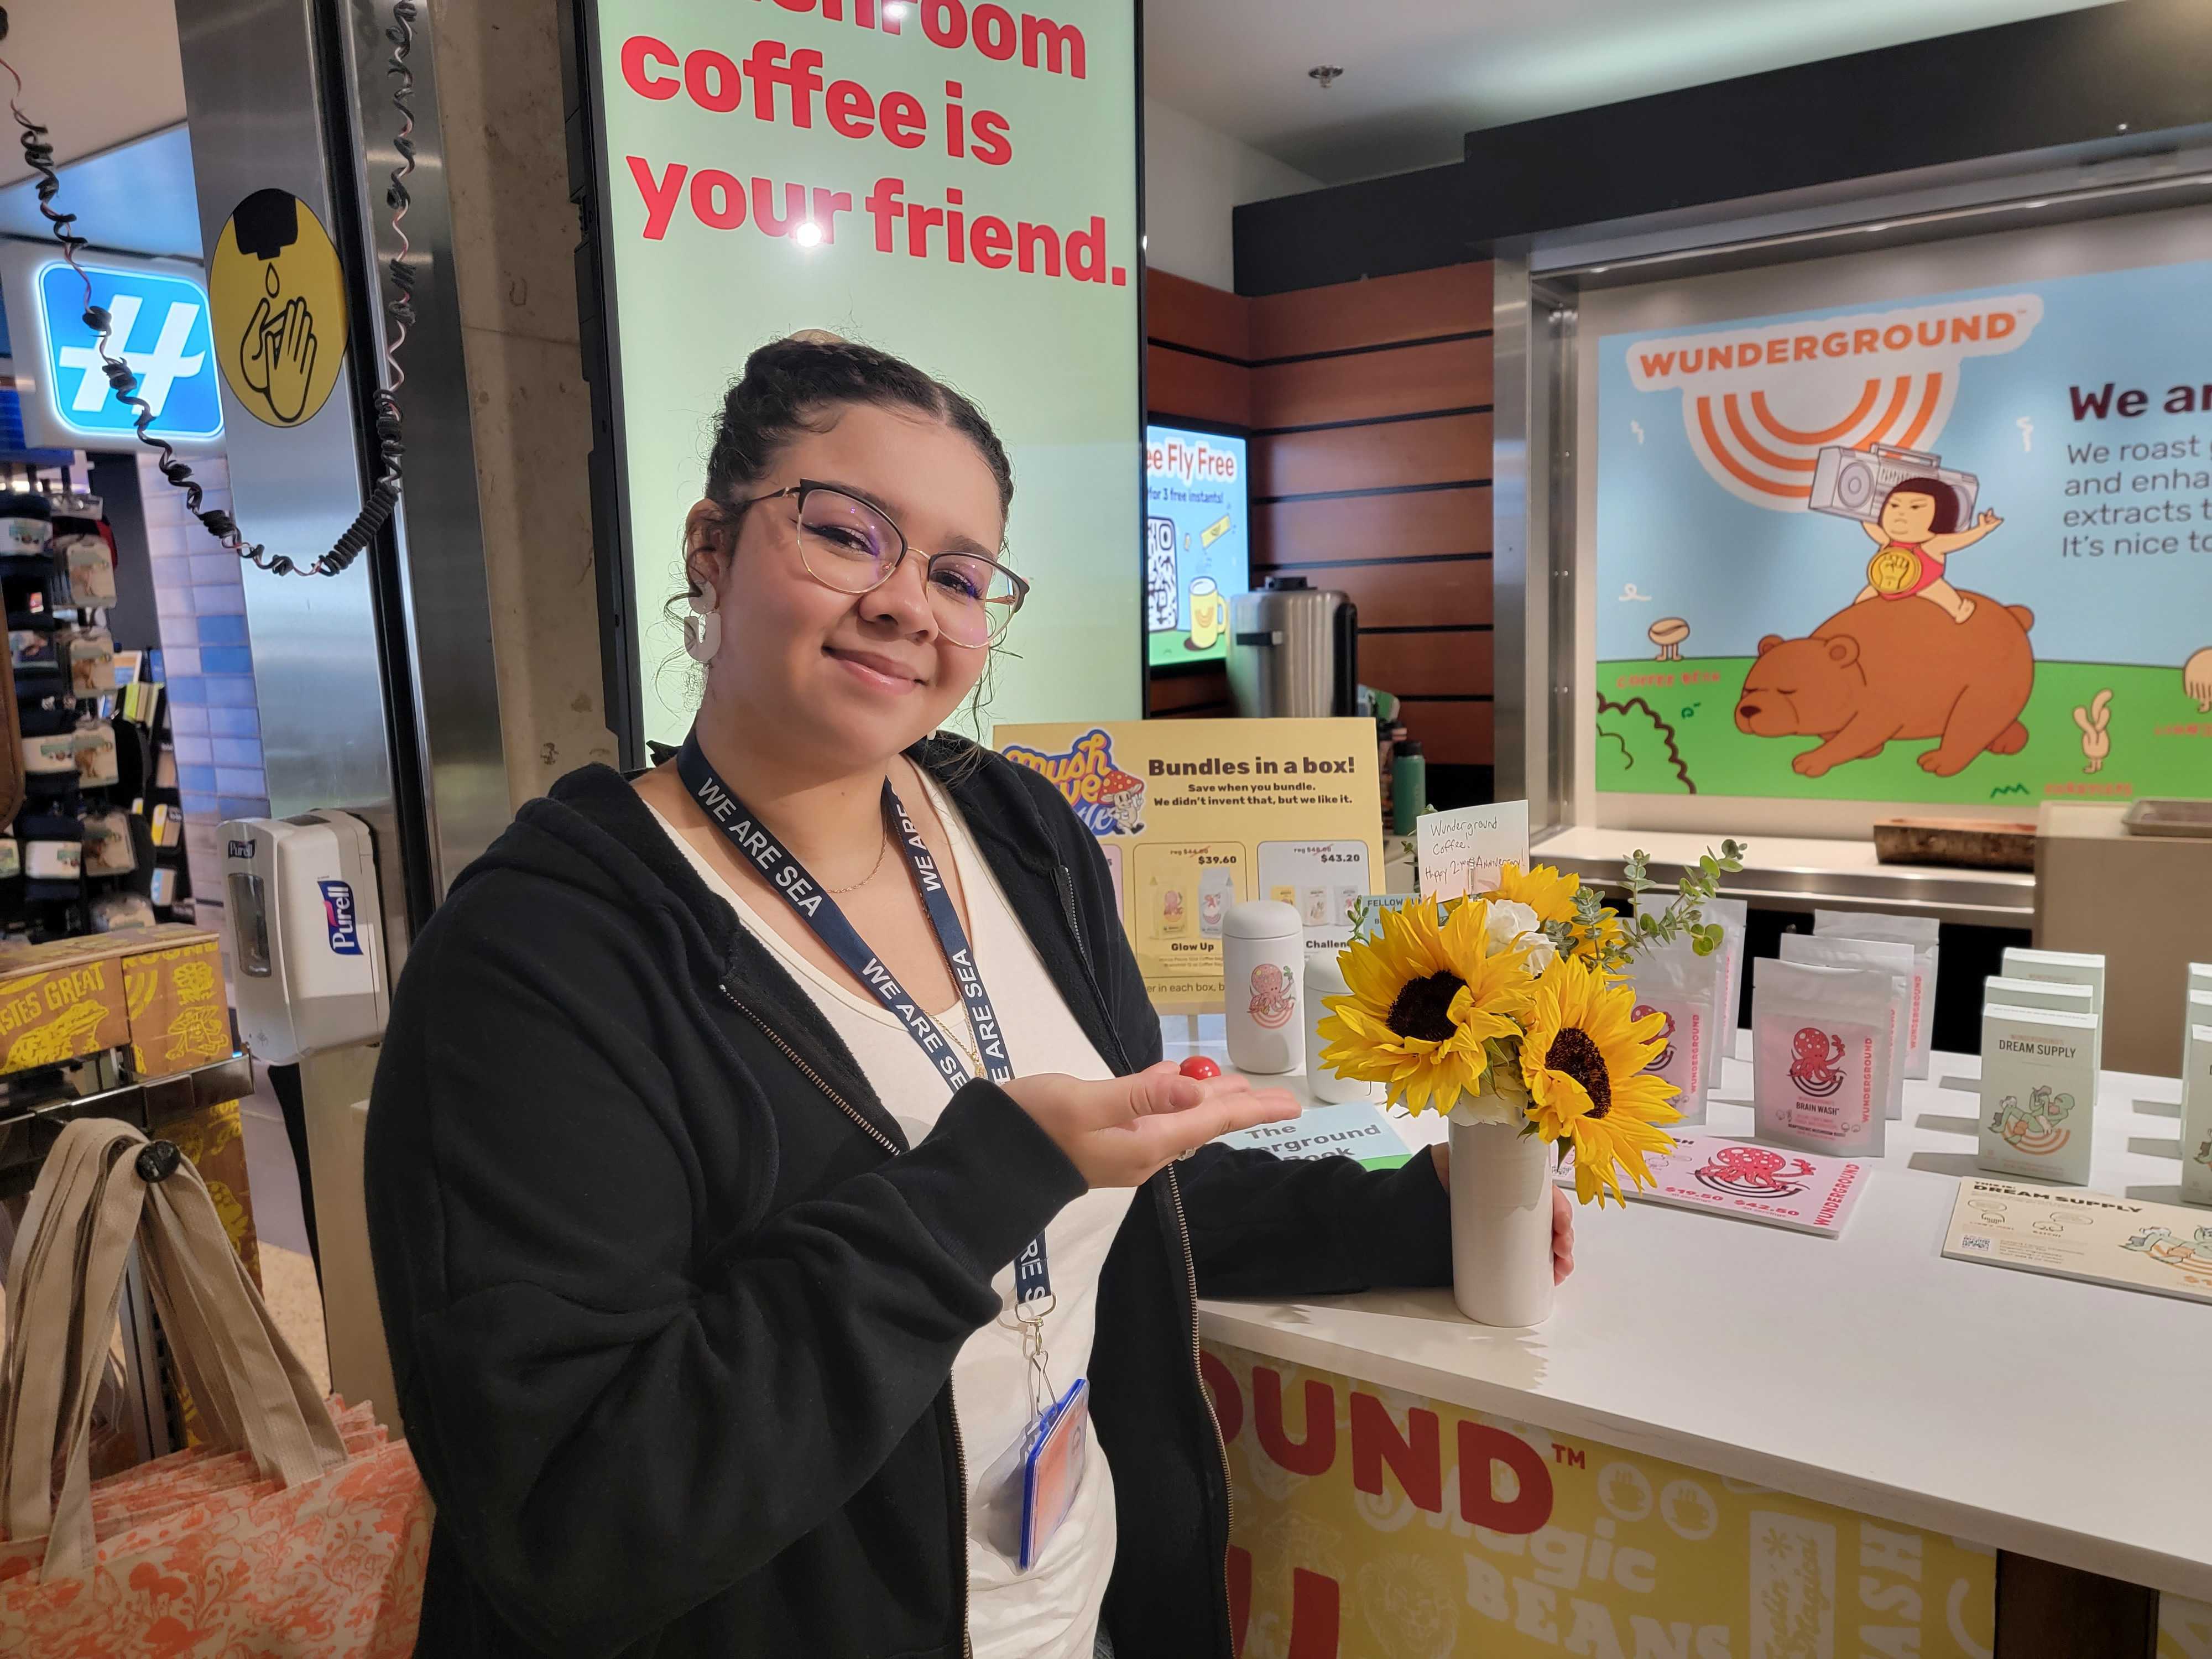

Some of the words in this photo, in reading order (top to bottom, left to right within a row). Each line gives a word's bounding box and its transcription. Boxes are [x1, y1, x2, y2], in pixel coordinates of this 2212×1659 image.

[621, 35, 927, 149] coffee
[946, 80, 1012, 165] is
[625, 155, 853, 243] your
[865, 178, 1126, 287] friend.
[2069, 382, 2149, 422] We
[1168, 443, 1193, 481] Fly
[1198, 446, 1234, 477] Free
[2067, 442, 2110, 465] We
[2119, 434, 2200, 462] roast
[1170, 487, 1187, 502] free
[2064, 471, 2122, 497] and
[2063, 499, 2192, 528] extracts
[2062, 533, 2105, 559] It's
[2114, 531, 2179, 556] nice
[1147, 758, 1251, 776] Bundles
[1255, 756, 1279, 775] in
[1283, 761, 1298, 774] a
[1303, 756, 1355, 774] box!
[1154, 797, 1170, 807] We
[1171, 796, 1207, 806] didn't
[1207, 796, 1245, 806] invent
[1246, 795, 1276, 805] that,
[1277, 795, 1298, 805] but
[1317, 794, 1338, 804] like
[1339, 794, 1353, 804] it.
[1187, 783, 1216, 793] Save
[1217, 783, 1249, 792] when
[1250, 784, 1272, 794] you
[1273, 782, 1316, 791] bundle.
[697, 777, 737, 823] WE
[728, 820, 782, 870] ARE
[775, 864, 824, 918] SEA
[1198, 855, 1237, 865] $39.60
[1321, 854, 1360, 863] $43.20
[914, 855, 942, 892] WE
[1368, 899, 1403, 907] FELLOW
[327, 886, 355, 949] Purell
[1171, 942, 1198, 951] Glow
[1199, 942, 1215, 952] Up
[43, 961, 106, 1010] GREAT
[952, 948, 983, 998] SEA
[1159, 983, 1167, 992] in
[1169, 983, 1193, 992] each
[1196, 982, 1217, 992] box,
[862, 958, 901, 999] WE
[895, 1002, 943, 1053] ARE
[972, 1004, 1005, 1060] ARE
[1999, 1039, 2034, 1054] DREAM
[2037, 1044, 2077, 1059] SUPPLY
[1861, 1037, 1873, 1124] WUNDERGROUND
[1796, 1101, 1817, 1113] BRAIN
[1245, 1125, 1297, 1140] The
[1665, 1186, 1724, 1202] $19.50
[1734, 1199, 1800, 1217] $42.50
[1813, 1164, 1860, 1227] WUNDERGROUND
[1974, 1185, 2051, 1199] DREAM
[2054, 1196, 2143, 1213] SUPPLY
